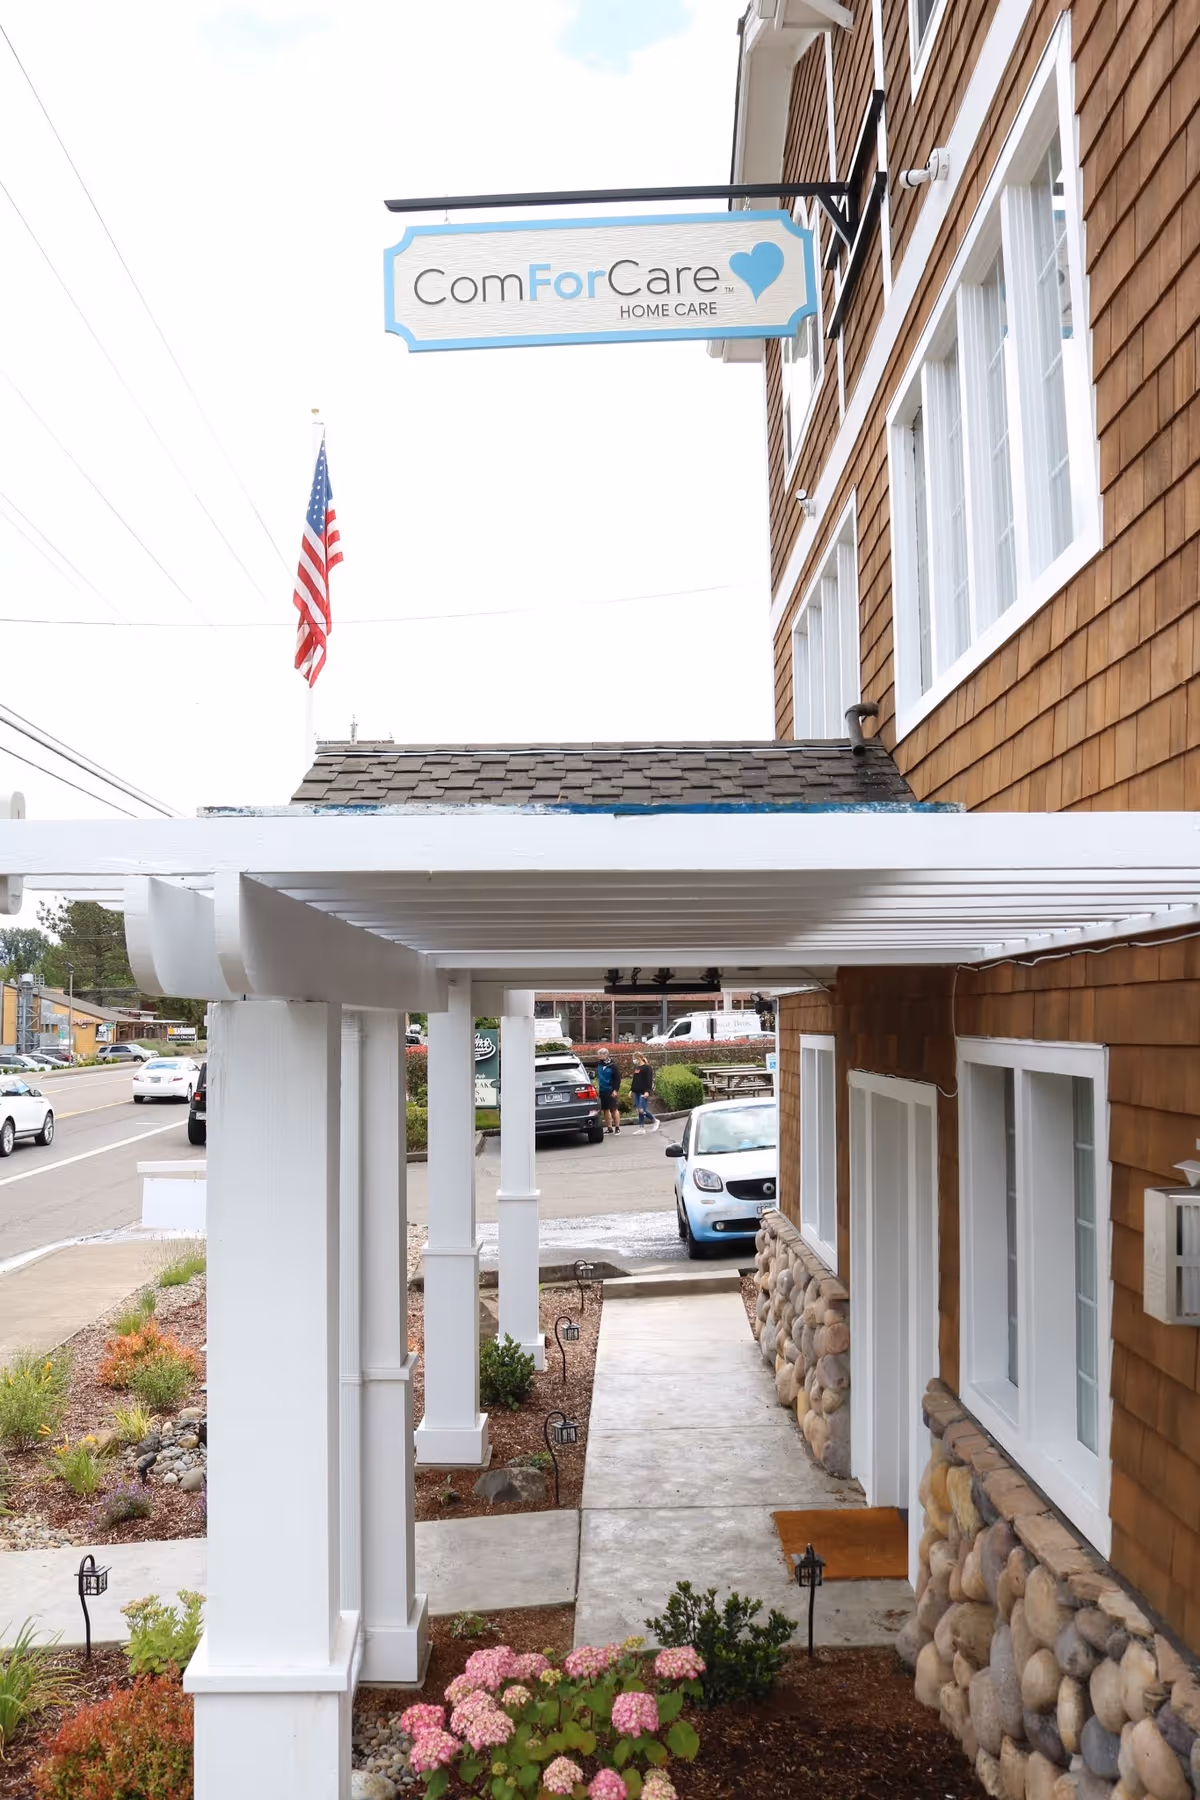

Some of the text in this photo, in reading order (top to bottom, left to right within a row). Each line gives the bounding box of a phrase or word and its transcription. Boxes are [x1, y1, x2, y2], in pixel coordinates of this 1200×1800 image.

[413, 259, 720, 305] ComForCare
[620, 301, 717, 318] HOME CARE
